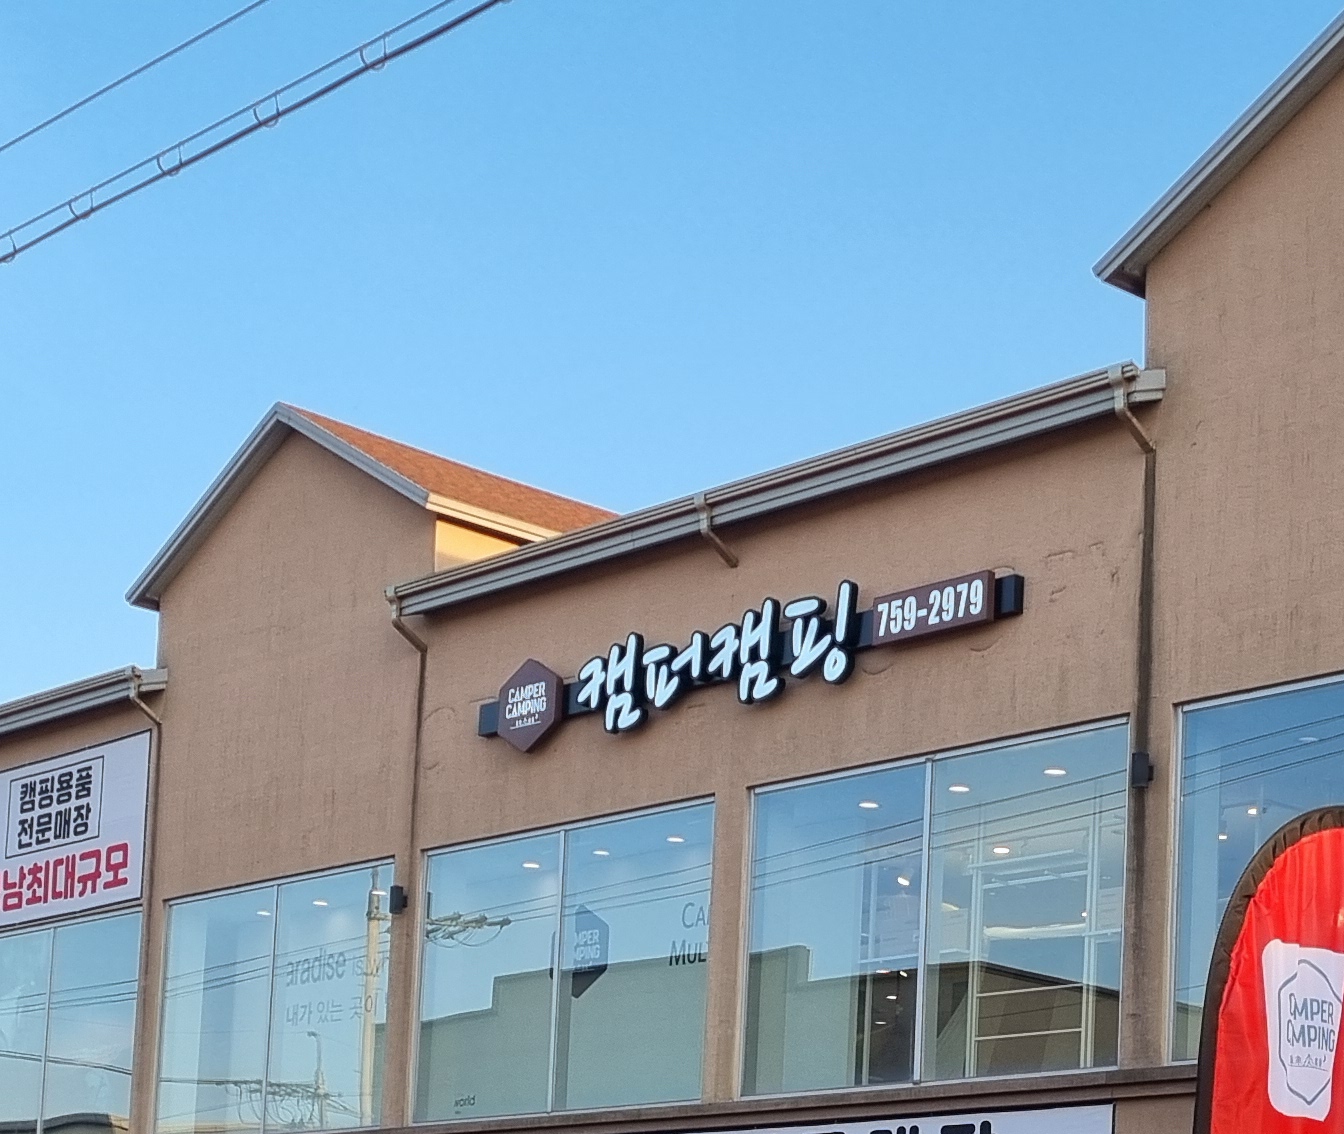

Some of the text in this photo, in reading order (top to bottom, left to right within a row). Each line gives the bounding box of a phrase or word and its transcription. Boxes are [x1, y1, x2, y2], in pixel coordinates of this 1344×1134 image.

[576, 578, 984, 732] 캠퍼캠핑 759-2979
[507, 681, 546, 704] CAMPER
[505, 696, 547, 720] CAMPING
[18, 764, 93, 815] 캠핑용품
[16, 801, 92, 850] 전문매장
[668, 939, 711, 967] MUL
[286, 1000, 313, 1027] 내가
[316, 998, 344, 1024] 있는
